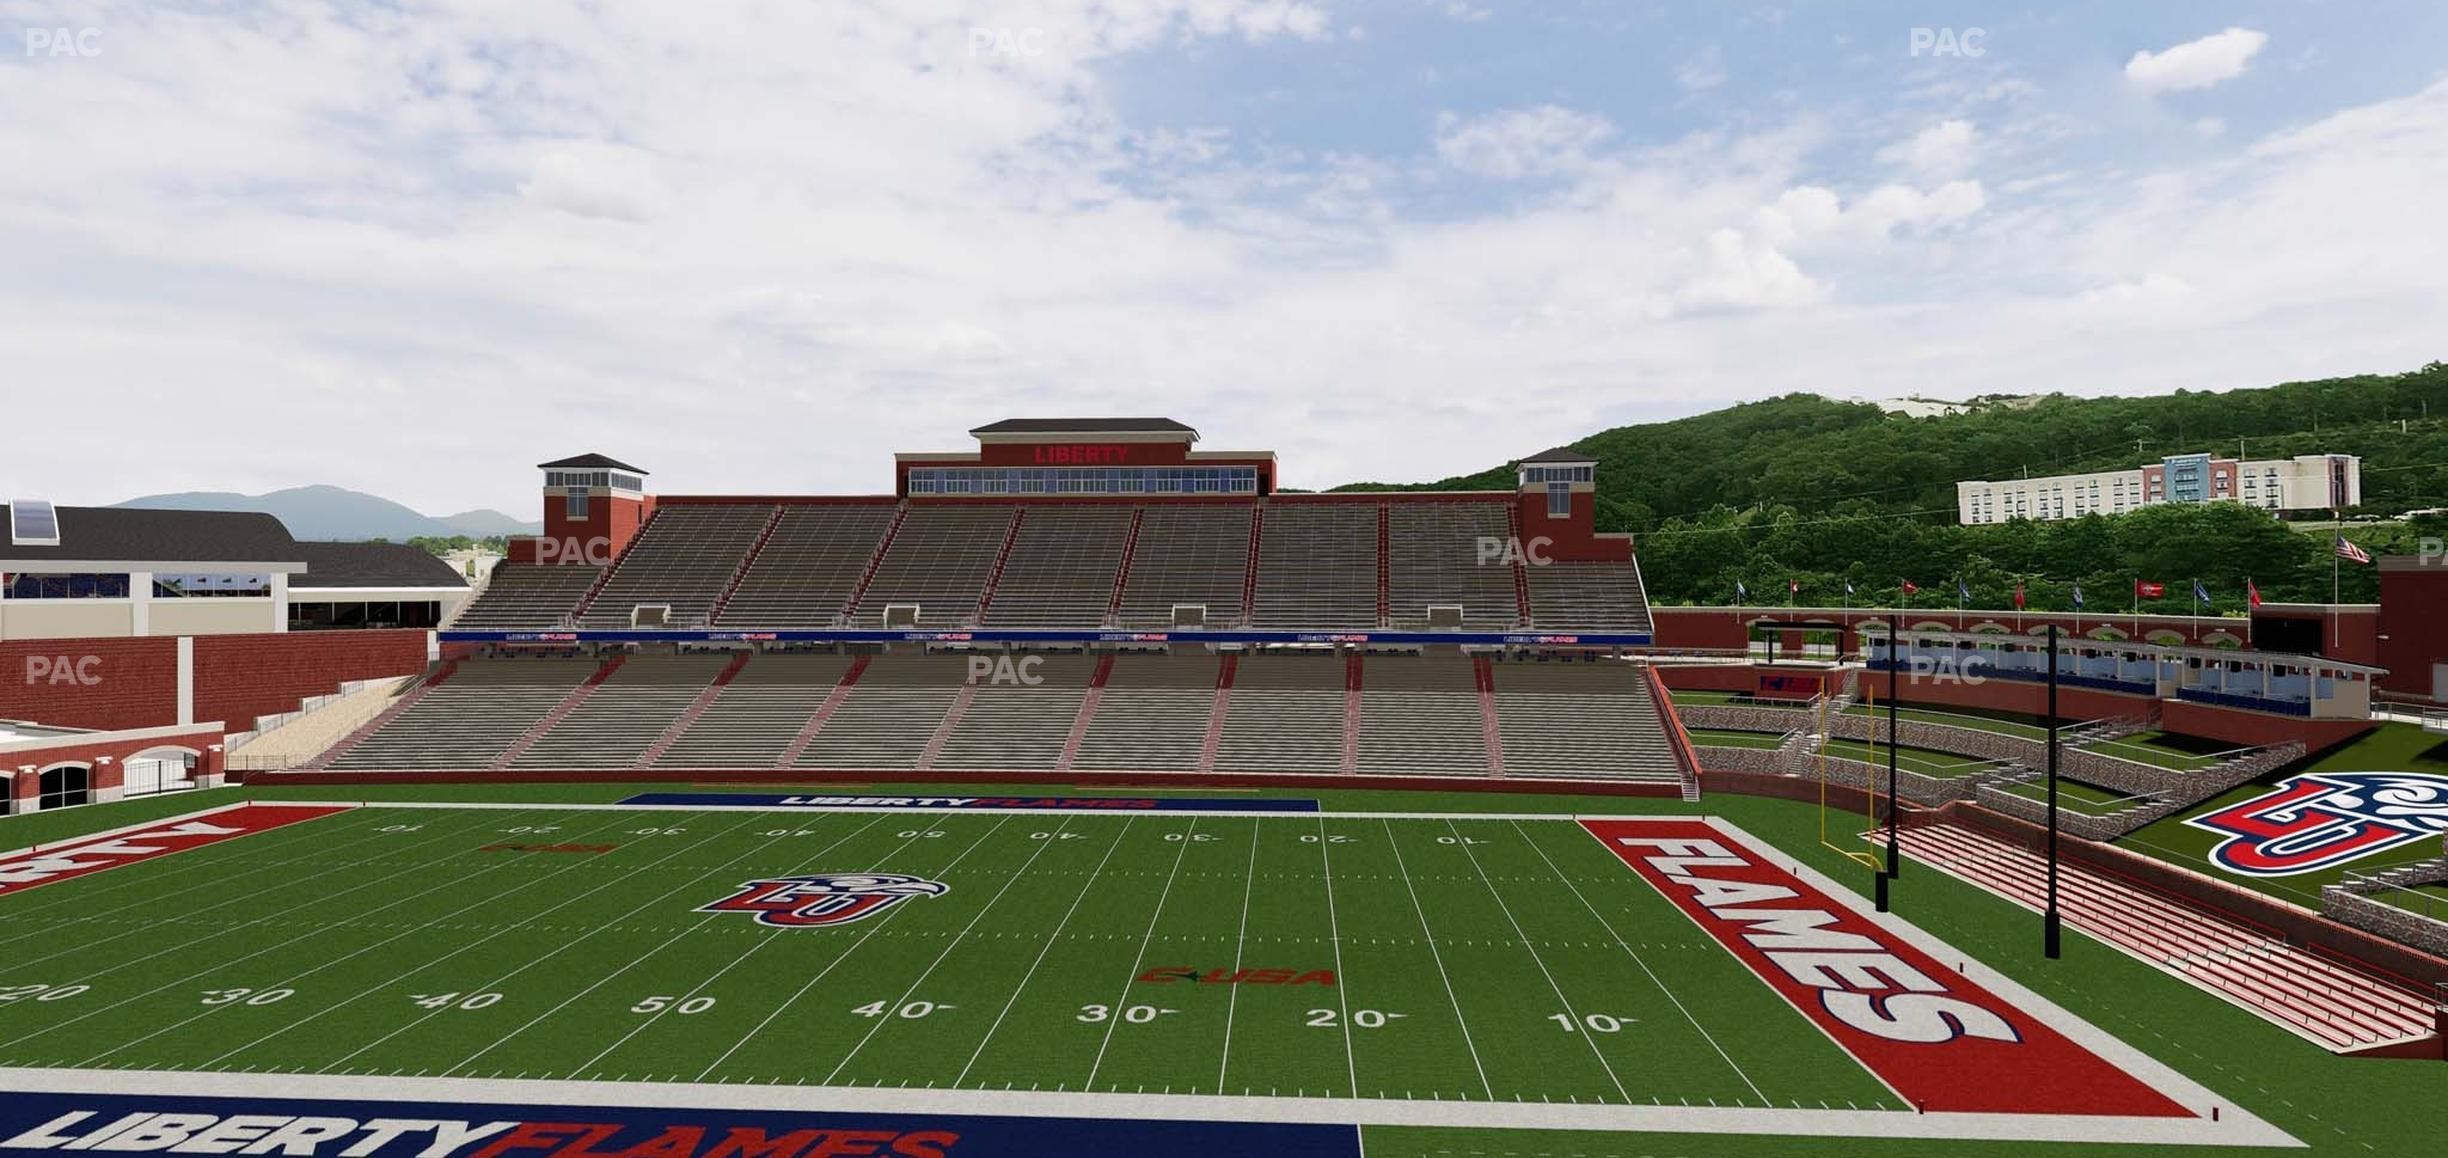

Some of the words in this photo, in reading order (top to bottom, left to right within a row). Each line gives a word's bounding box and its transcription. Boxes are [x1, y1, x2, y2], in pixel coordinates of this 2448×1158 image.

[1034, 446, 1129, 463] LIBERTY
[779, 796, 977, 806] LIBERTY
[1300, 835, 1348, 843] 20
[1617, 837, 2024, 1045] FLAMES
[202, 988, 295, 1005] 30
[418, 992, 503, 1010] 40
[631, 997, 716, 1015] 50
[851, 1001, 932, 1019] 40
[1076, 1004, 1157, 1023] 30
[1306, 1009, 1386, 1028] 20
[1547, 1013, 1622, 1034] 10
[0, 1110, 523, 1158] LIBERTY
